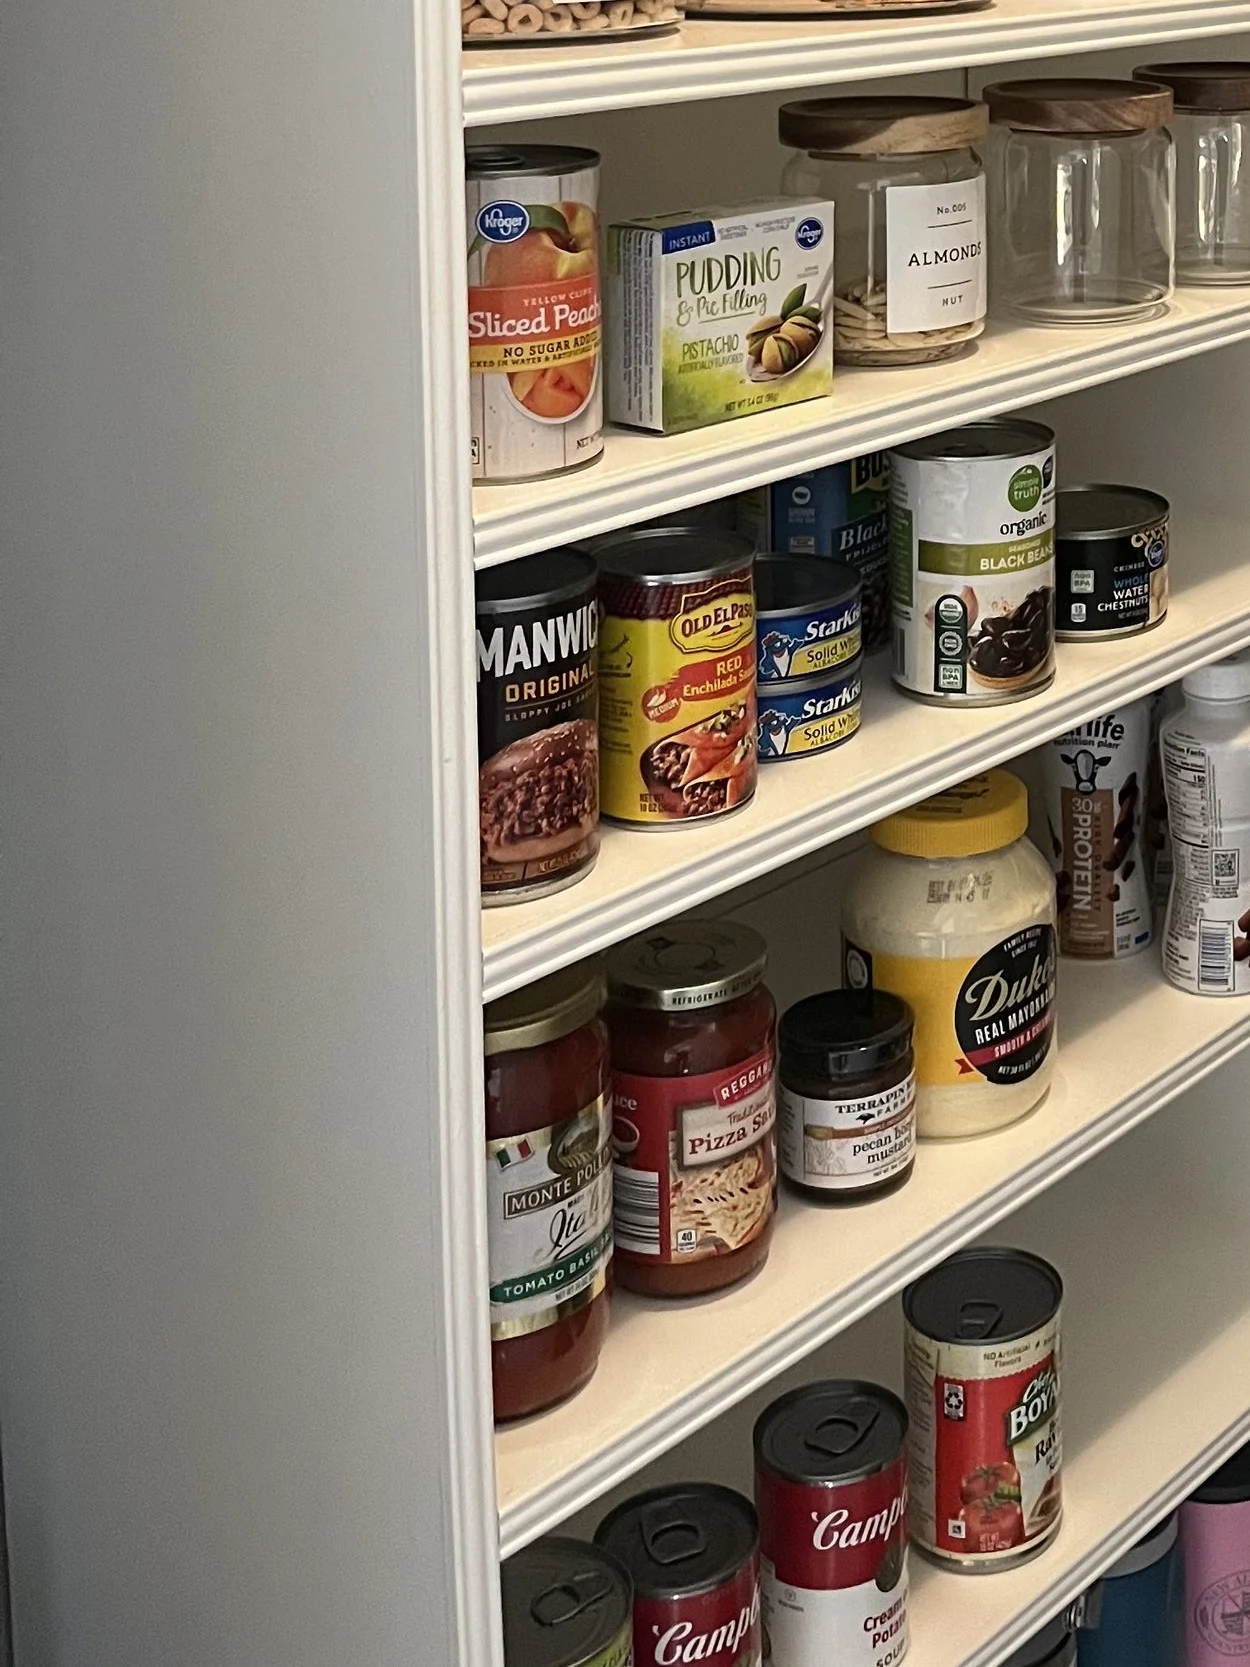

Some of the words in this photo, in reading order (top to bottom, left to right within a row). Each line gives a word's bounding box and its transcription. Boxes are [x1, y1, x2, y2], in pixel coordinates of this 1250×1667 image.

[485, 208, 523, 235] Kroger
[669, 231, 711, 250] INSTANT
[797, 225, 823, 244] Kroger
[907, 241, 982, 268] ALMONDS
[676, 246, 781, 298] PUDDING
[523, 292, 566, 307] YELLOW
[676, 300, 694, 327] &
[697, 295, 720, 320] Pie
[722, 288, 768, 316] Filling
[942, 295, 964, 307] NUT
[468, 306, 551, 338] Sliced
[503, 345, 524, 358] NO
[529, 340, 571, 356] SUGAR
[682, 333, 739, 363] PISTACHIO
[511, 355, 542, 366] WATER
[1013, 477, 1041, 491] simple
[1013, 486, 1040, 501] truth
[1000, 511, 1047, 537] organic
[1008, 539, 1041, 552] SEASONED
[980, 555, 1025, 571] BLACK
[1073, 579, 1091, 587] BPA
[1113, 574, 1149, 589] WHOLE
[1097, 595, 1149, 613] CHESTNUTS
[681, 615, 711, 638] OLD
[807, 642, 837, 663] Solid
[716, 655, 742, 677] RED
[505, 661, 594, 703] ORIGINAL
[683, 675, 737, 697] Enchilada
[942, 673, 959, 681] BPA
[505, 706, 549, 722] SLOPPY
[555, 699, 571, 712] JOE
[647, 697, 679, 719] MEDIUM
[804, 719, 835, 740] Solid
[1098, 739, 1121, 750] plan
[1072, 813, 1093, 911] PROTEIN
[1003, 933, 1025, 953] FAMILY
[1011, 945, 1027, 958] SINCE
[672, 990, 728, 1005] REFRIGERATE
[975, 1019, 1006, 1046] REAL
[994, 1034, 1026, 1058] SMOOTH
[835, 1088, 904, 1114] TERRAPIN
[688, 1125, 747, 1156] Pizza
[853, 1135, 892, 1156] pecan
[511, 1177, 572, 1212] MONTE
[681, 1232, 693, 1242] 40
[504, 1269, 565, 1297] TOMATO
[570, 1248, 599, 1274] BASIL
[984, 1352, 996, 1361] NO
[998, 1343, 1031, 1359] Artificial
[994, 1356, 1022, 1368] Flavors
[863, 1595, 904, 1633] Cream
